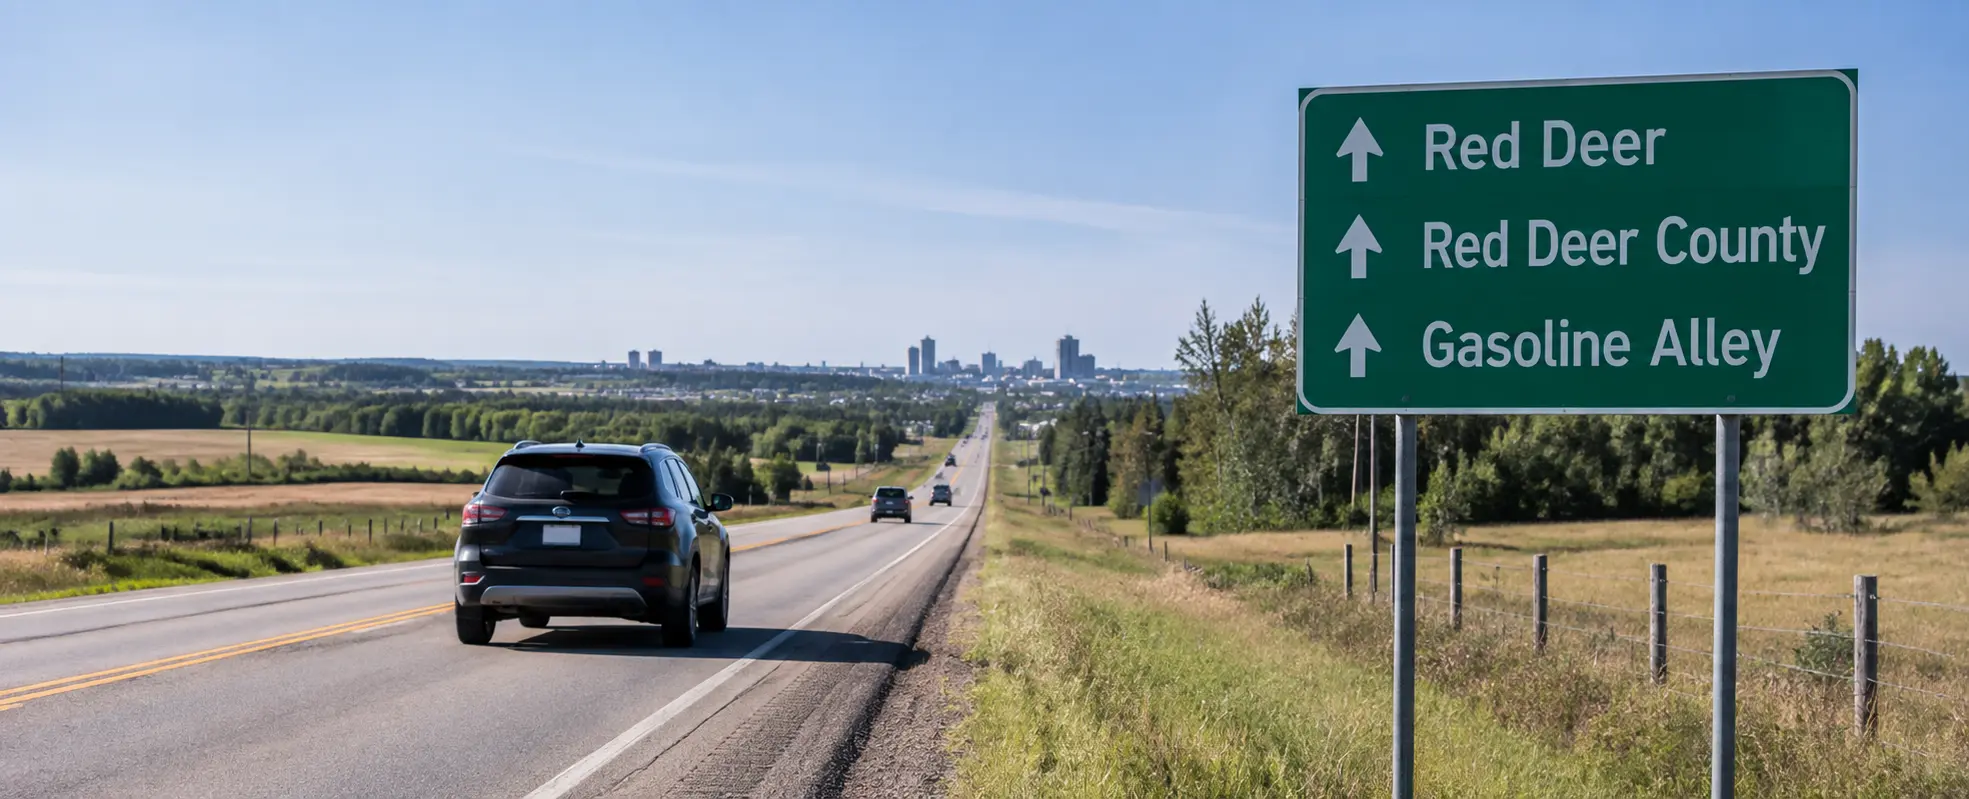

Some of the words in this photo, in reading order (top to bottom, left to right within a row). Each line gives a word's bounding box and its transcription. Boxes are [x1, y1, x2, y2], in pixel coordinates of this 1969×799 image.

[1424, 120, 1520, 171] Red
[1543, 119, 1667, 167] Deer
[1424, 219, 1508, 269] Red
[1528, 219, 1639, 267] Deer
[1657, 215, 1826, 275] County
[1422, 318, 1631, 368] Gasoline
[1650, 317, 1781, 379] Alley
